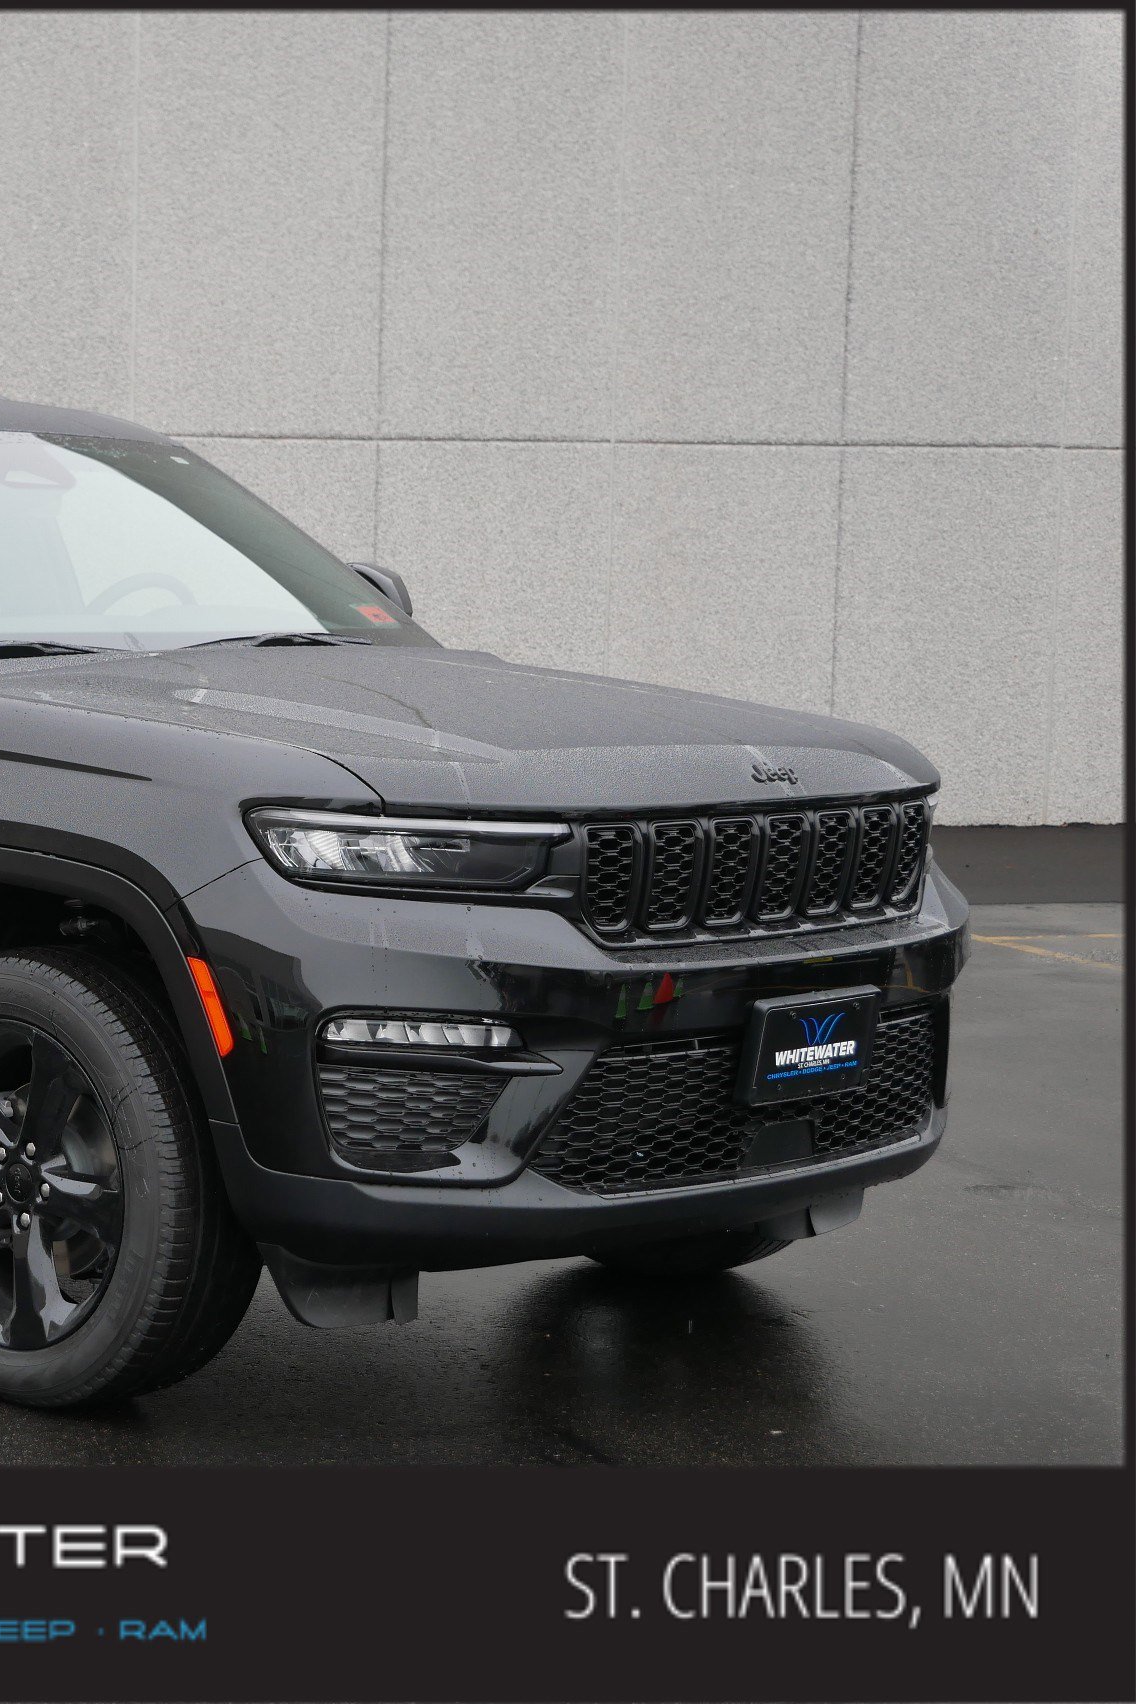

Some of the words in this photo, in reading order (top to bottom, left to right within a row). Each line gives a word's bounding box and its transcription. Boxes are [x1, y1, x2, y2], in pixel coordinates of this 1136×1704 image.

[751, 764, 799, 785] Jeep
[775, 1040, 855, 1066] WHITEWATER
[767, 1070, 799, 1080] CHRYSLER
[802, 1066, 822, 1075] DODGE
[844, 1060, 857, 1068] RAM
